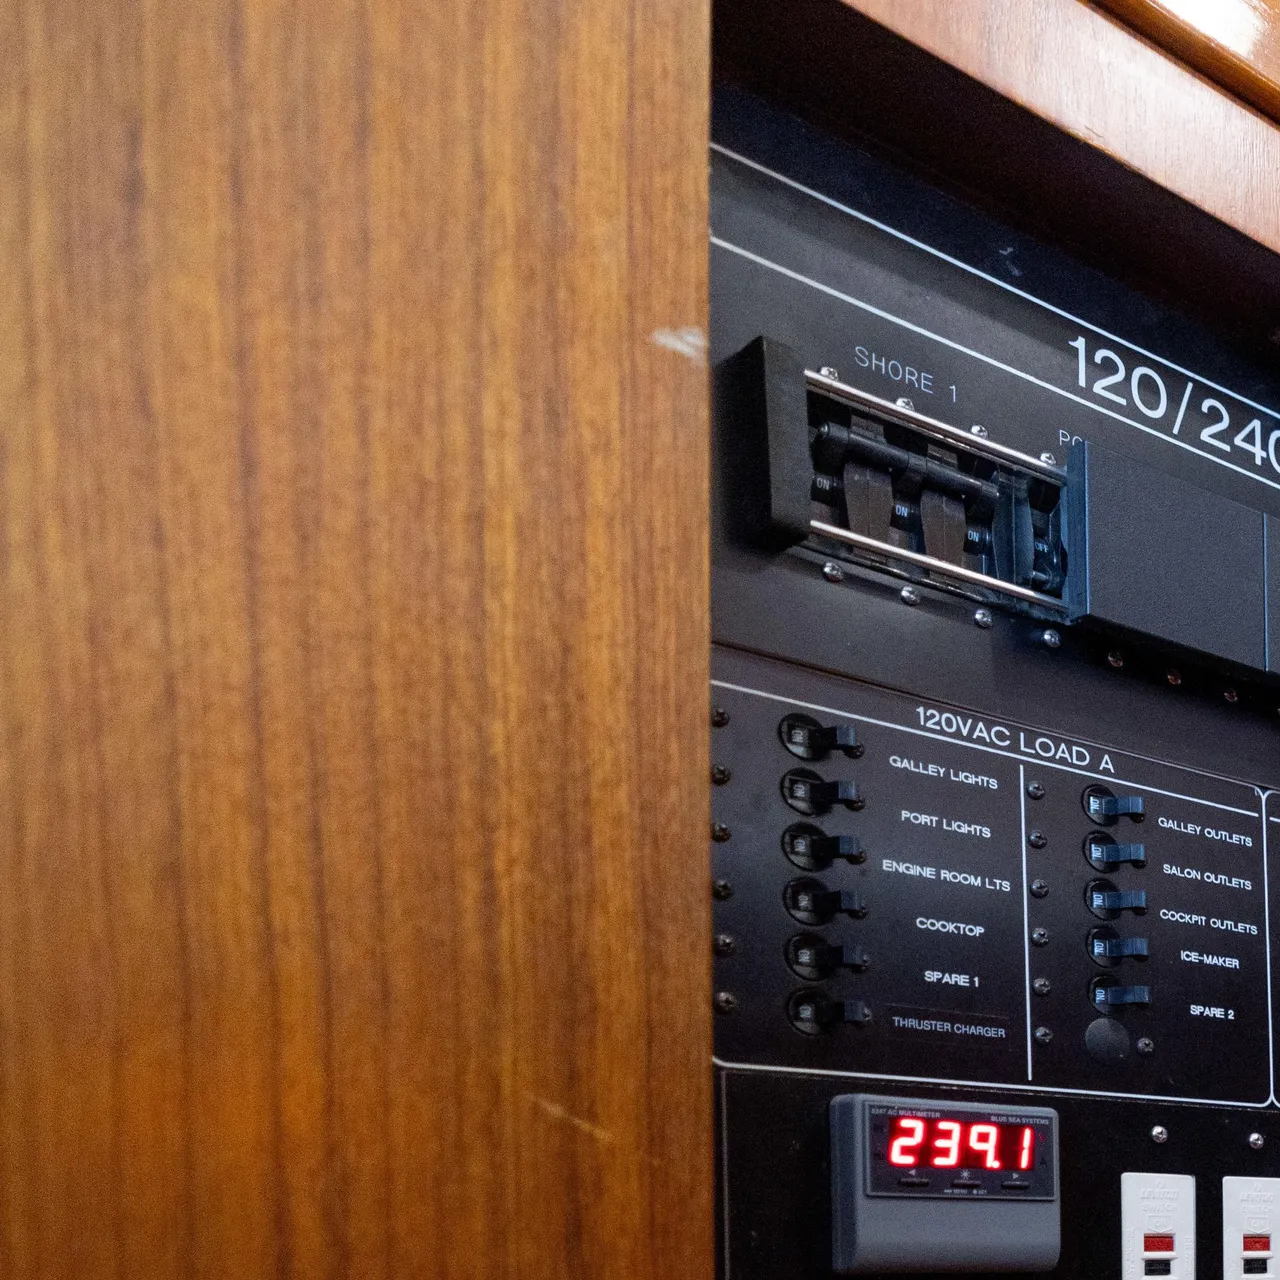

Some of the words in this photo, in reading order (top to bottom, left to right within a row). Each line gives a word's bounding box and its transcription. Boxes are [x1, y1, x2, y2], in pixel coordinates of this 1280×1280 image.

[854, 345, 934, 395] SHORE
[948, 384, 959, 403] 1
[915, 706, 1011, 747] 120VAC
[1020, 732, 1091, 766] LOAD
[1099, 754, 1115, 774] A
[889, 755, 946, 777] GALLEY
[950, 769, 998, 790] LIGHTS
[901, 810, 938, 828] PORT
[943, 819, 991, 838] LIGHTS
[1158, 816, 1201, 836] GALLEY
[1204, 827, 1253, 847] OUTLETS
[882, 859, 936, 879] ENGINE
[940, 870, 982, 887] ROOM
[985, 878, 1011, 892] LTS
[1163, 863, 1201, 880] SALON
[1204, 872, 1252, 890] OUTLETS
[915, 917, 985, 937] COOKTOP
[1159, 909, 1206, 926] COCKPIT
[1210, 918, 1258, 935] OUTLETS
[1180, 950, 1240, 969] ICE-MAKER
[924, 970, 970, 987] SPARE
[973, 976, 980, 988] 1
[1190, 1004, 1225, 1019] SPARE
[1227, 1010, 1235, 1020] 2
[892, 1016, 951, 1033] THRUSTER
[953, 1022, 1006, 1039] CHARGER
[888, 1118, 1034, 1170] 239.1
